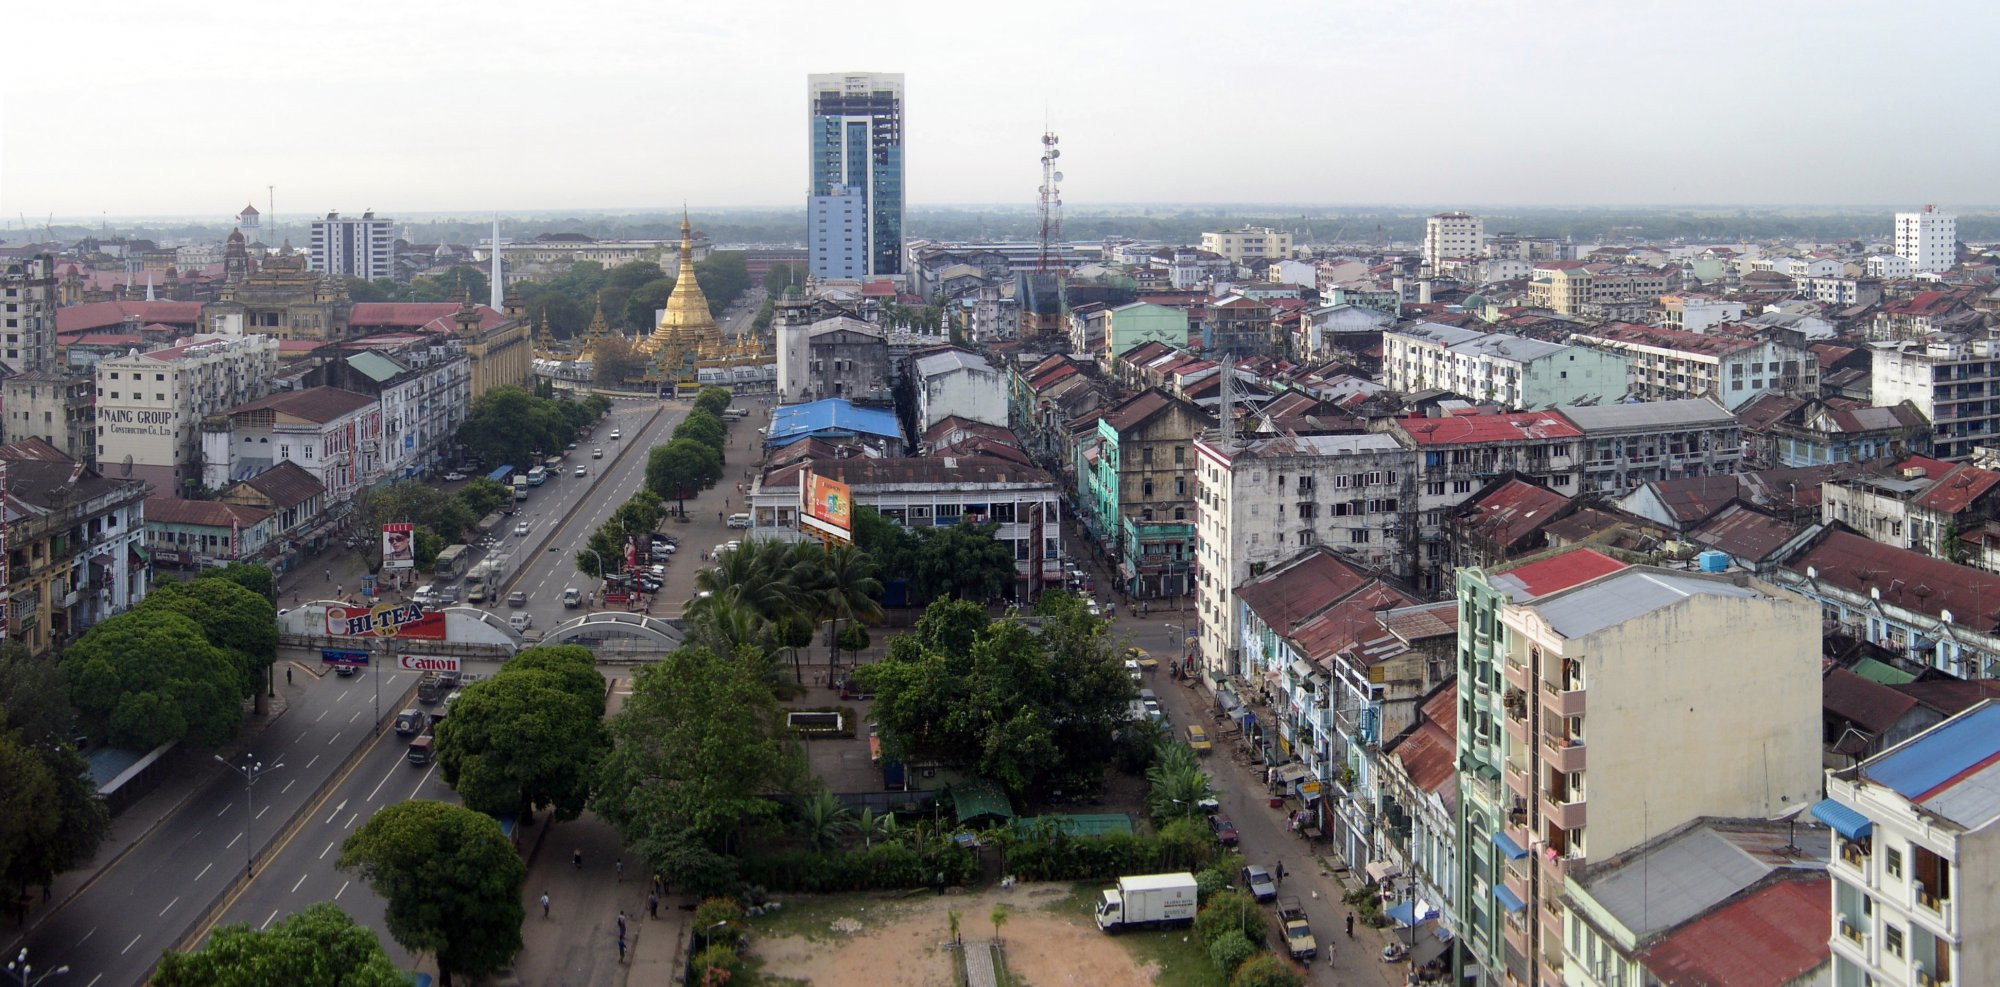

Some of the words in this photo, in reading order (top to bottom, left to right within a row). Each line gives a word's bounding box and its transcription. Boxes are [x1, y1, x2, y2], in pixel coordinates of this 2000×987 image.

[104, 409, 132, 423] NAING
[138, 411, 172, 424] GROUP
[347, 602, 423, 636] HI-TEA
[401, 656, 457, 671] Canon
